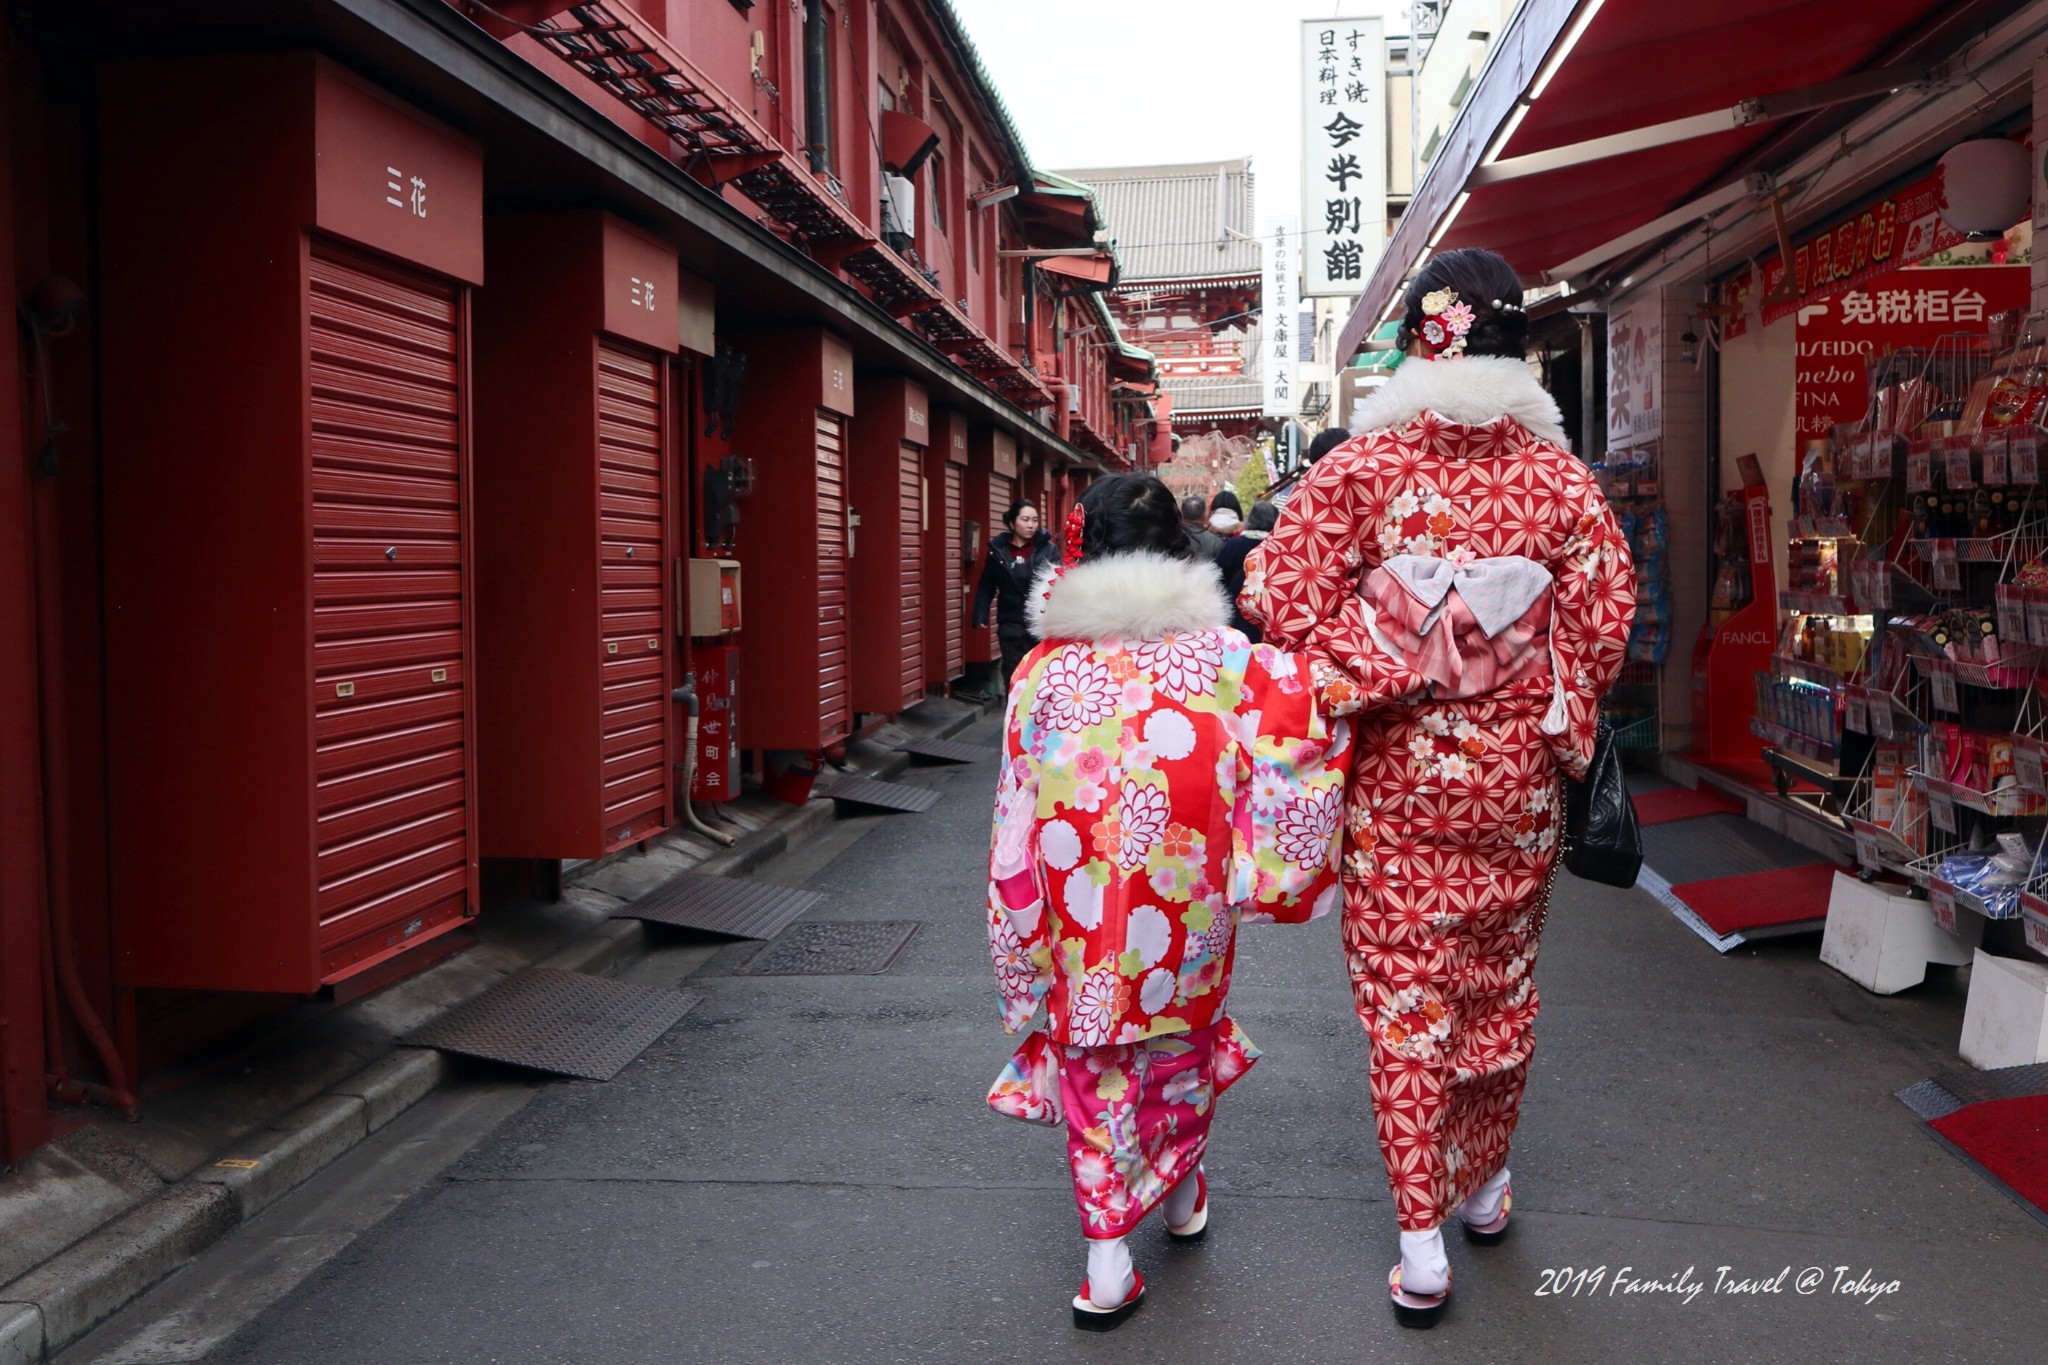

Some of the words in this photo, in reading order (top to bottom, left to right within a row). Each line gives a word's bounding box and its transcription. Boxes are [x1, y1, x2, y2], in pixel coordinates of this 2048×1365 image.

[1318, 29, 1339, 106] 日本料理
[1345, 29, 1369, 104] すき焼
[387, 167, 426, 218] 三花
[631, 278, 655, 311] 三花
[1841, 288, 1987, 325] 免税柜台
[1722, 631, 1771, 645] FANCL
[701, 668, 723, 787] 仲見世町会
